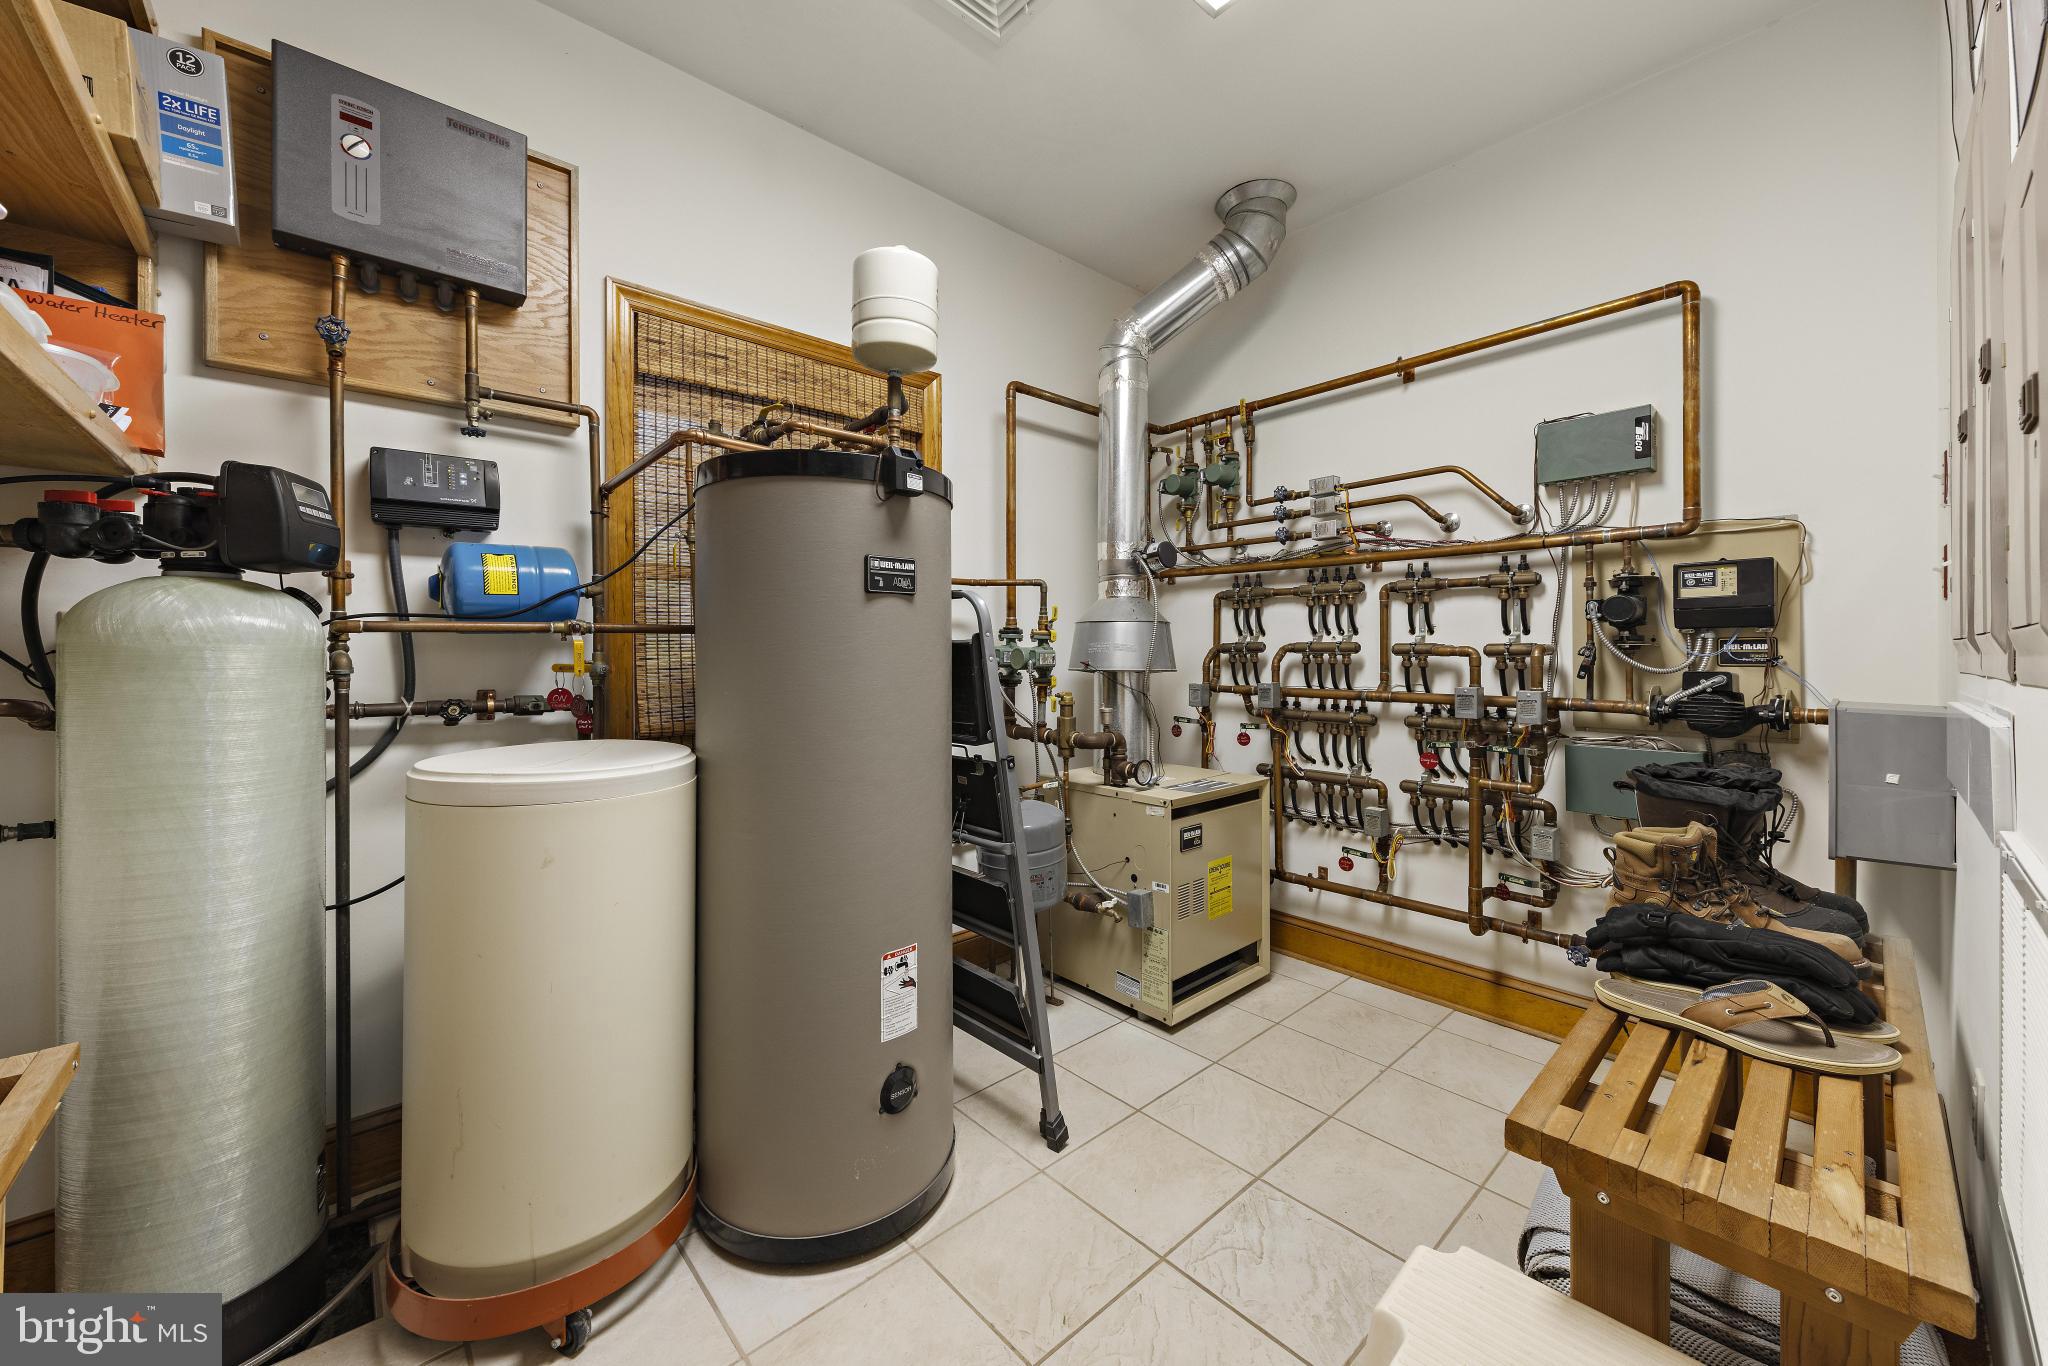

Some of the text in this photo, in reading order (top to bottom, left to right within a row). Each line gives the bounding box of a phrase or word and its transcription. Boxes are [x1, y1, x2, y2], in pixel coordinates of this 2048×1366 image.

[176, 52, 196, 67] 12
[176, 63, 196, 73] PACK
[162, 95, 218, 120] 2x LIFE
[177, 124, 206, 137] Daylight
[446, 116, 510, 148] Tempra Plus
[26, 294, 165, 329] Water Heater
[1635, 421, 1649, 452] Taco
[552, 694, 568, 702] ON
[894, 946, 913, 957] DANGER
[890, 1085, 912, 1100] SENSOR
